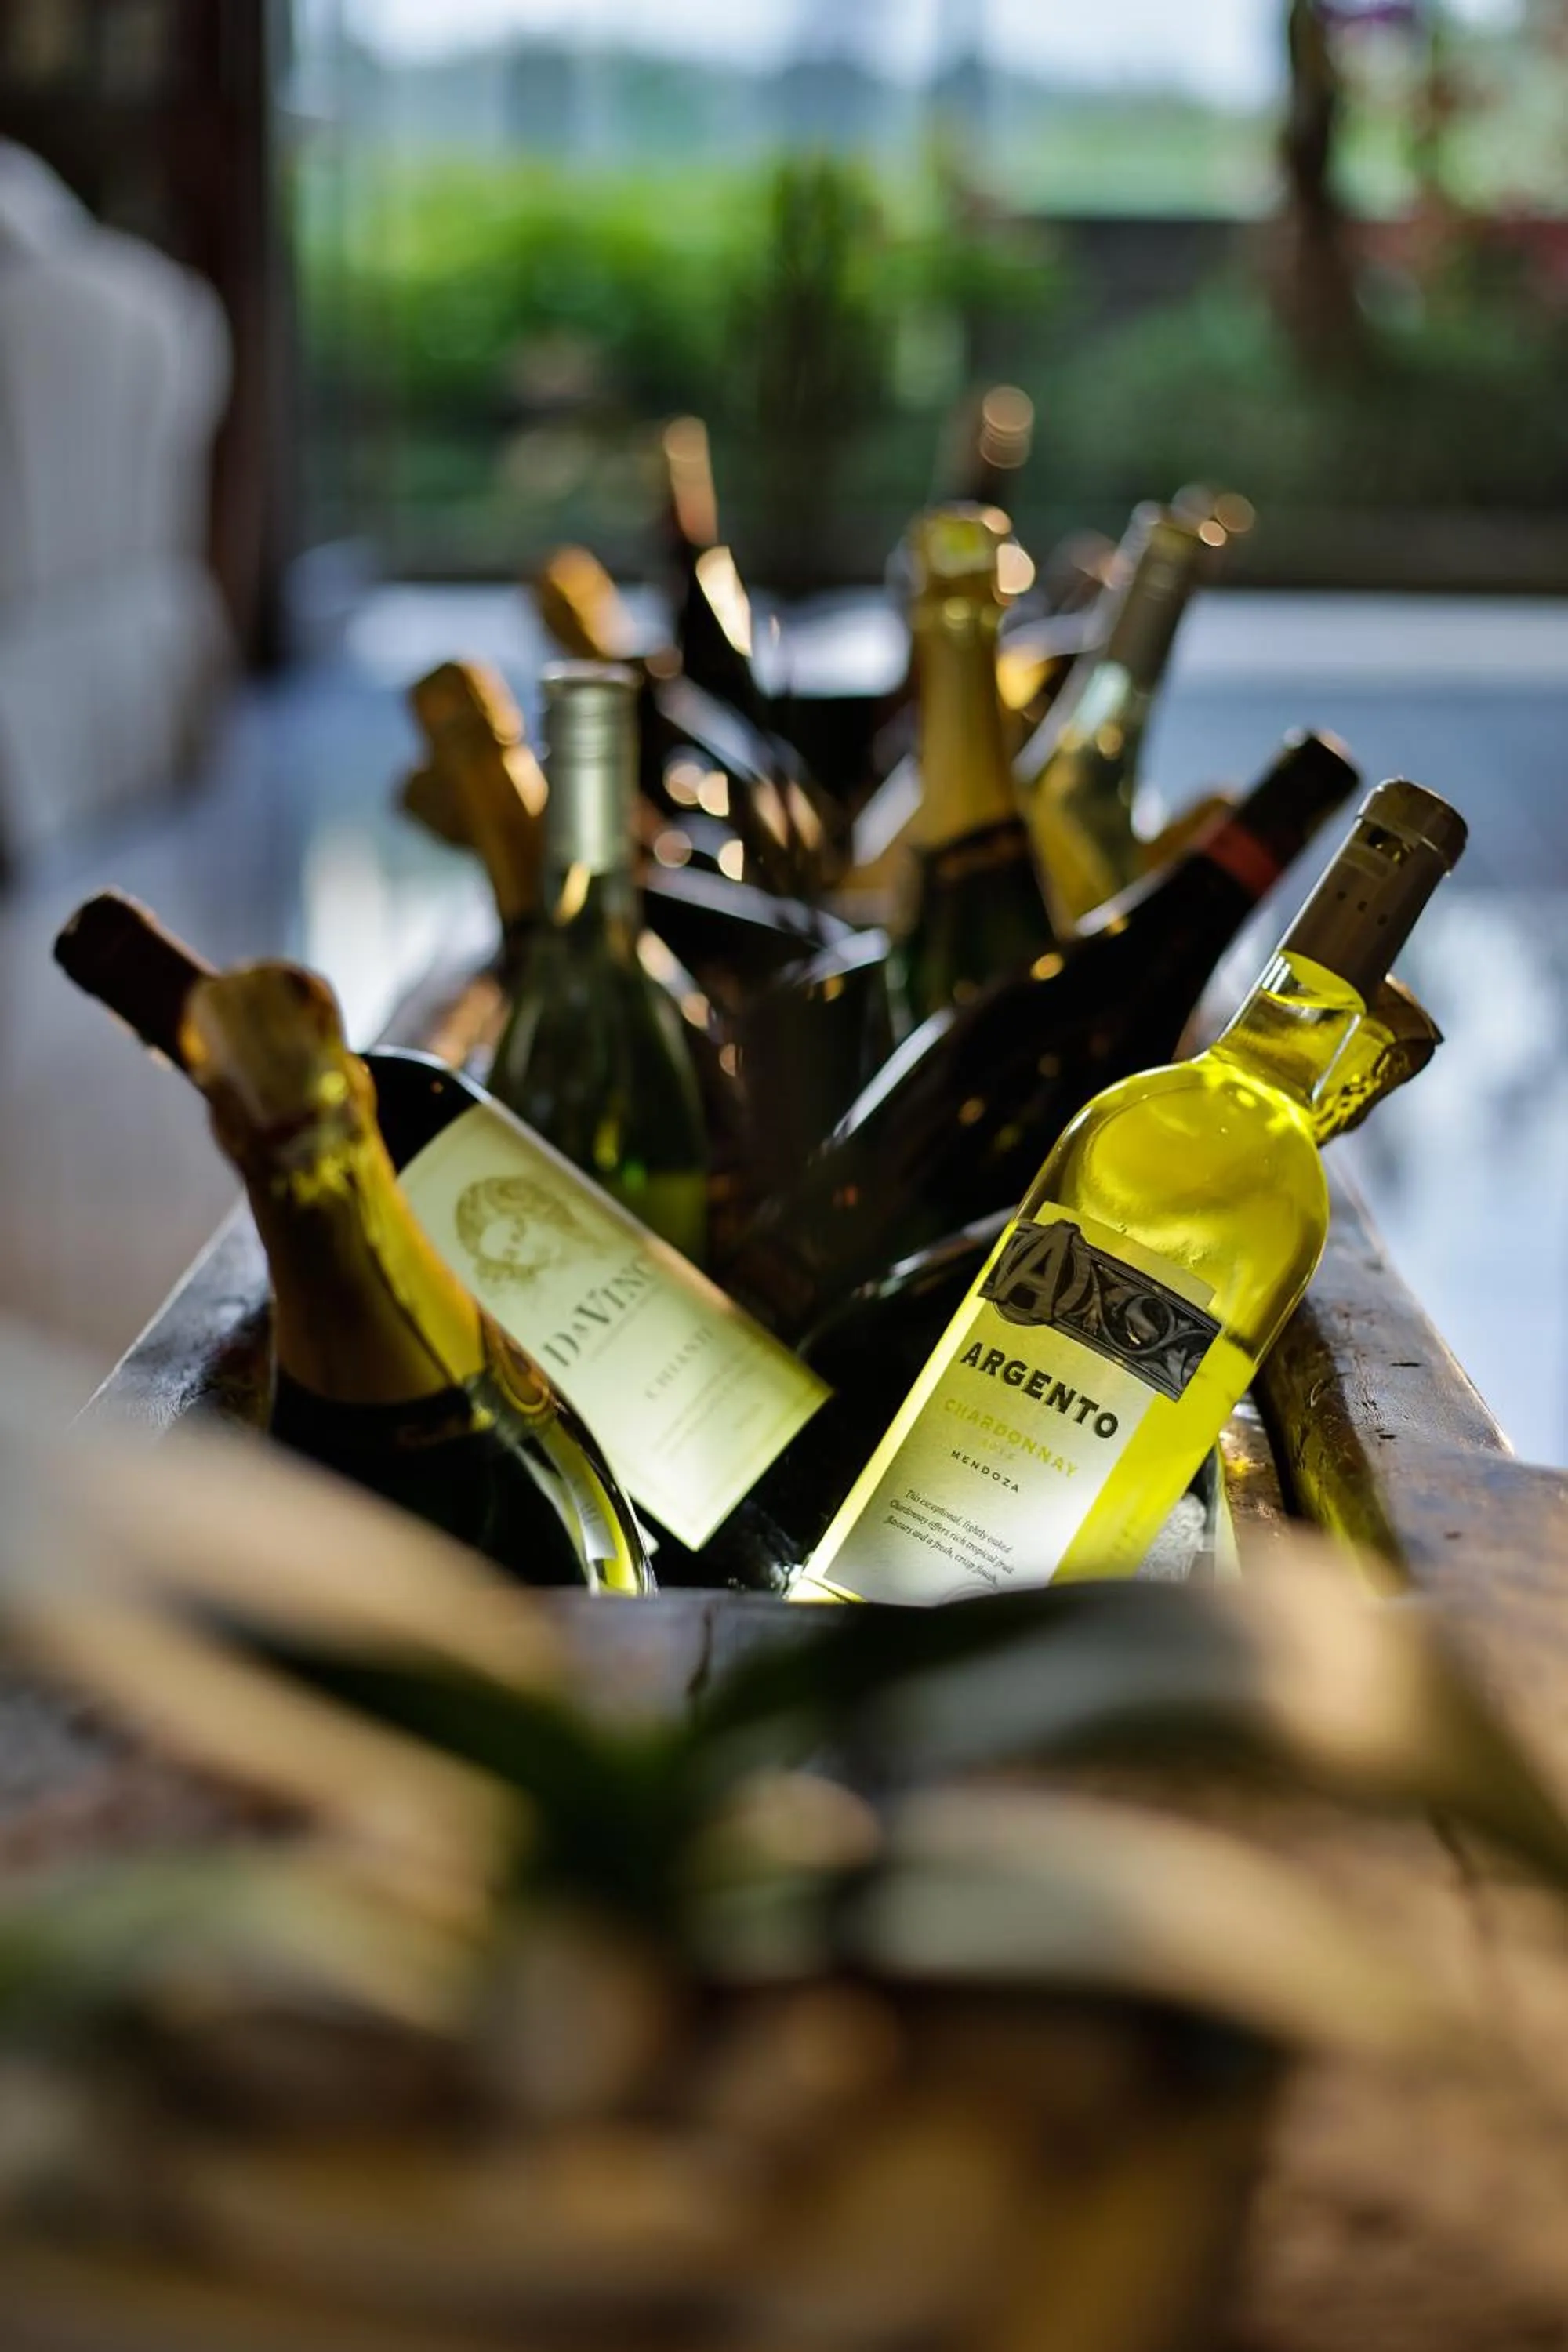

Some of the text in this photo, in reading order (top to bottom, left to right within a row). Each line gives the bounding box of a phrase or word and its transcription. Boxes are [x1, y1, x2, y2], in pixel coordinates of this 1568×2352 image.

[960, 1341, 1119, 1439] ARGENTO
[944, 1399, 1078, 1478] CHARDONNAY
[950, 1450, 1018, 1493] MENDOZA
[949, 1533, 967, 1546] rich
